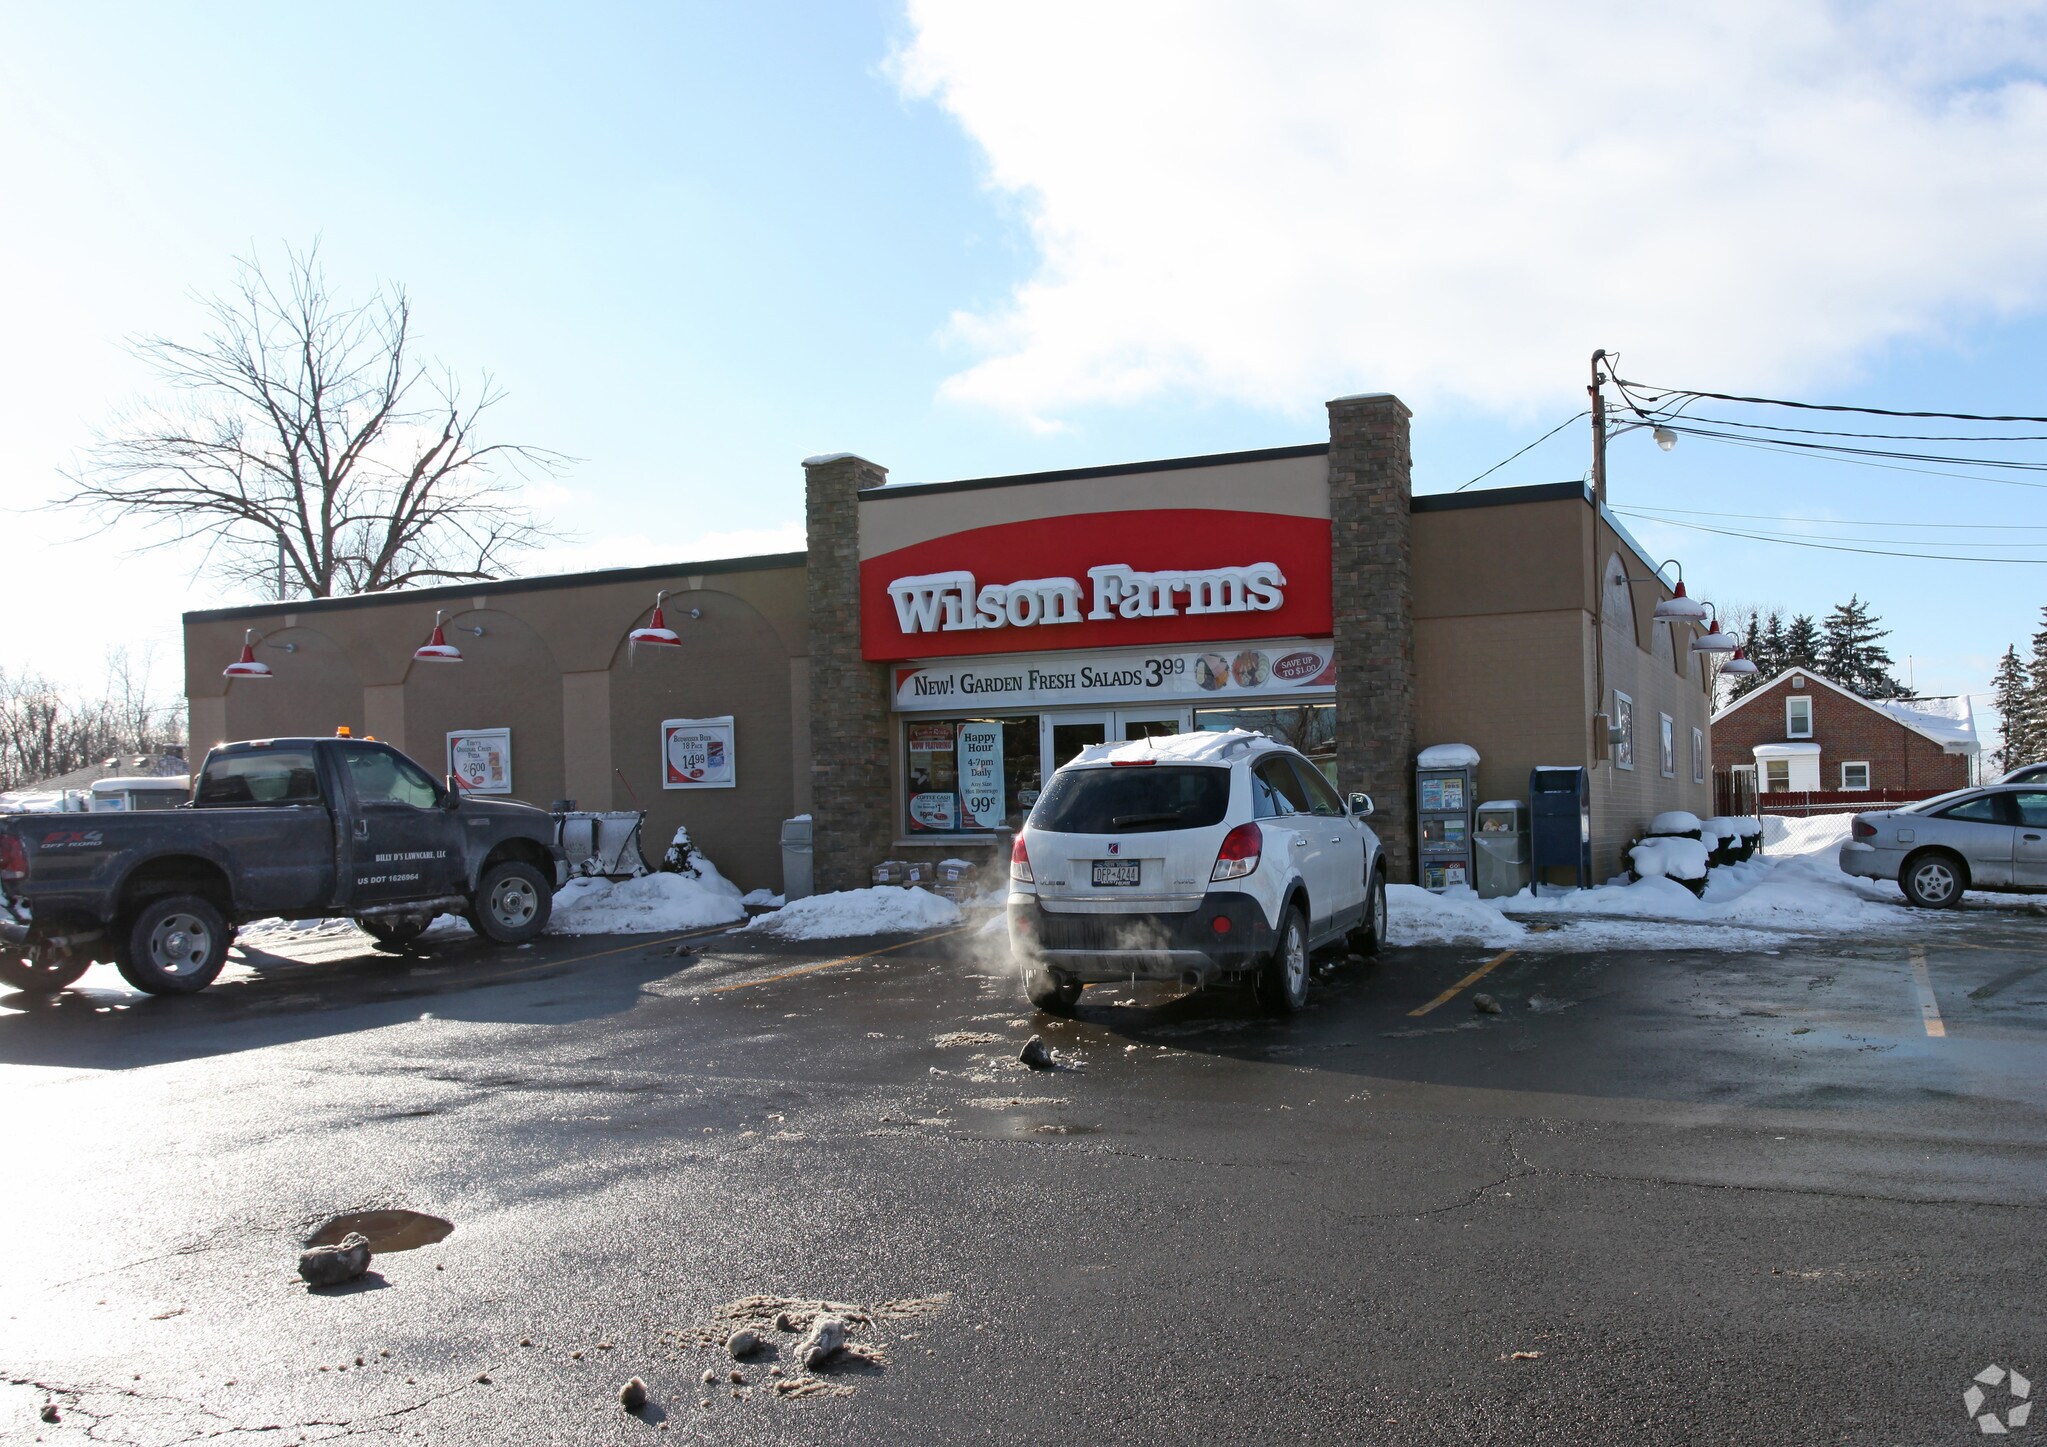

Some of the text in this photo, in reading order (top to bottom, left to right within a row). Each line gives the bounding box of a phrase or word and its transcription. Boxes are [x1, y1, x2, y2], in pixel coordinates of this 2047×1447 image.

[887, 564, 1285, 633] Wilson Farms
[1281, 656, 1313, 669] SAVE UP
[1282, 664, 1317, 677] TO $1.00
[914, 674, 954, 695] NEW!
[960, 673, 1022, 693] GARDEN
[1028, 670, 1075, 690] FRESH
[1080, 667, 1142, 688] SALADS
[964, 733, 996, 744] Happy
[682, 742, 690, 750] 18
[968, 743, 993, 752] Hour
[967, 758, 994, 768] 4-7pm
[971, 768, 992, 778] Daily
[43, 830, 104, 844] FX4
[68, 840, 103, 848] ROAD
[375, 853, 393, 862] BILLY
[393, 852, 404, 861] D'S
[436, 850, 447, 858] LLC
[357, 877, 369, 885] US
[370, 876, 386, 884] DOT
